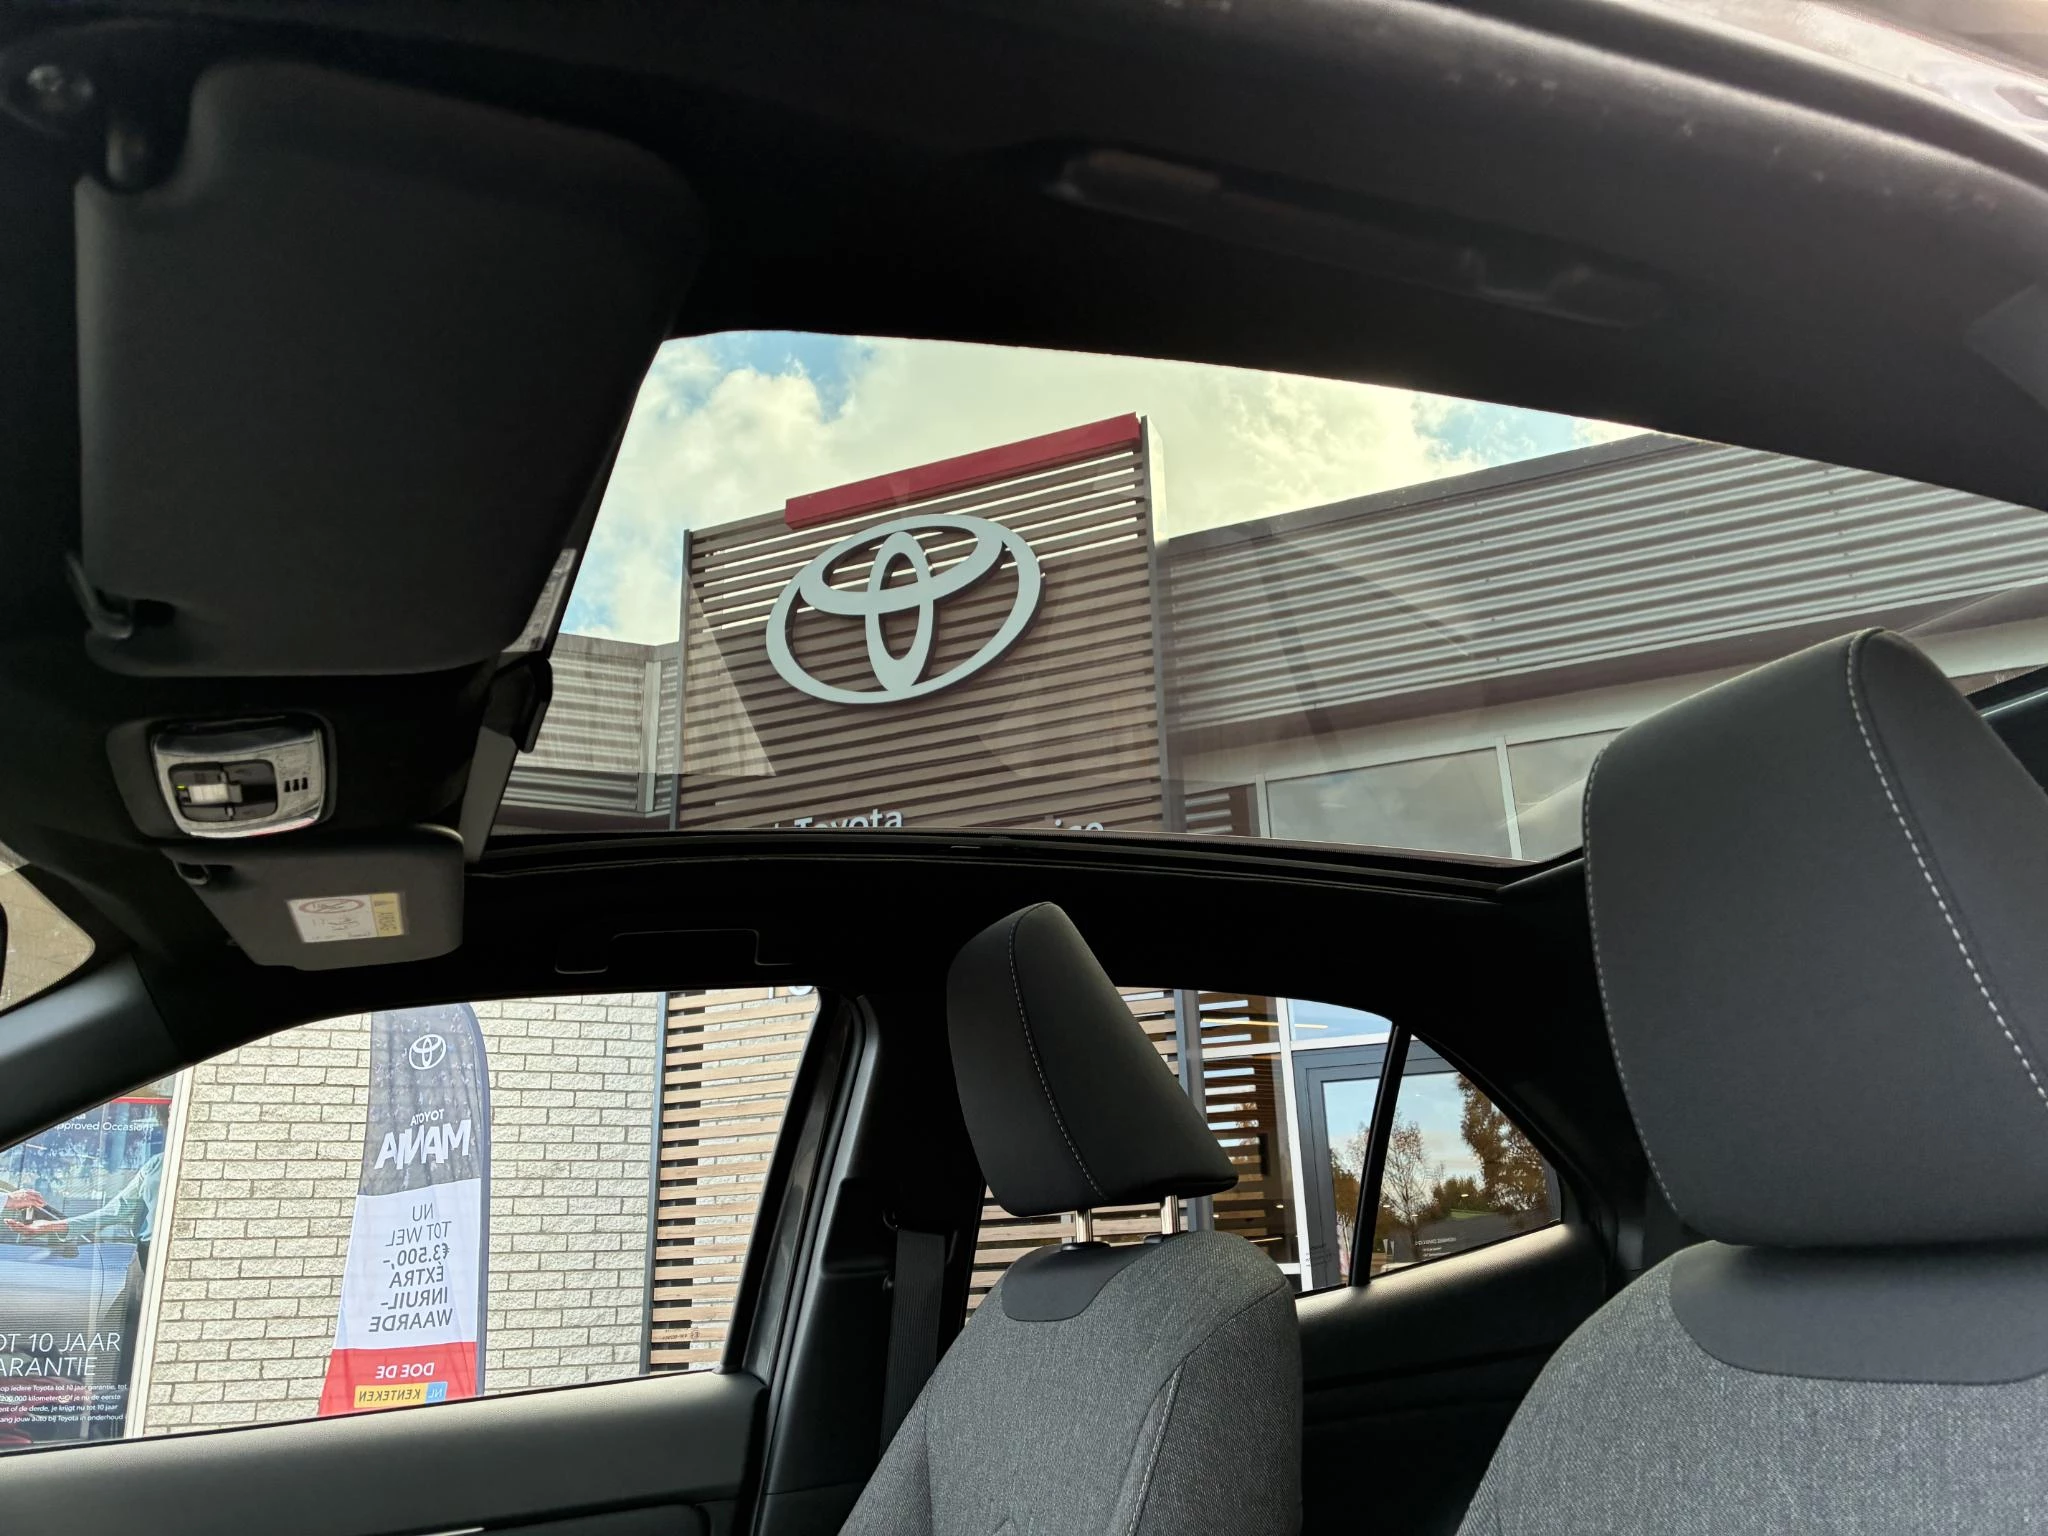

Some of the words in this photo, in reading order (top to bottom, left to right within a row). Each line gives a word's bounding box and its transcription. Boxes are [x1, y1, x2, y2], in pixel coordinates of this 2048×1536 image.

[56, 1121, 100, 1132] pproved
[102, 1121, 154, 1132] Occasions
[28, 1332, 54, 1353] 10
[58, 1332, 121, 1352] JAAR
[11, 1383, 32, 1392] iedere
[33, 1382, 54, 1393] Toyota
[55, 1383, 65, 1391] tot
[117, 1383, 128, 1391] tot
